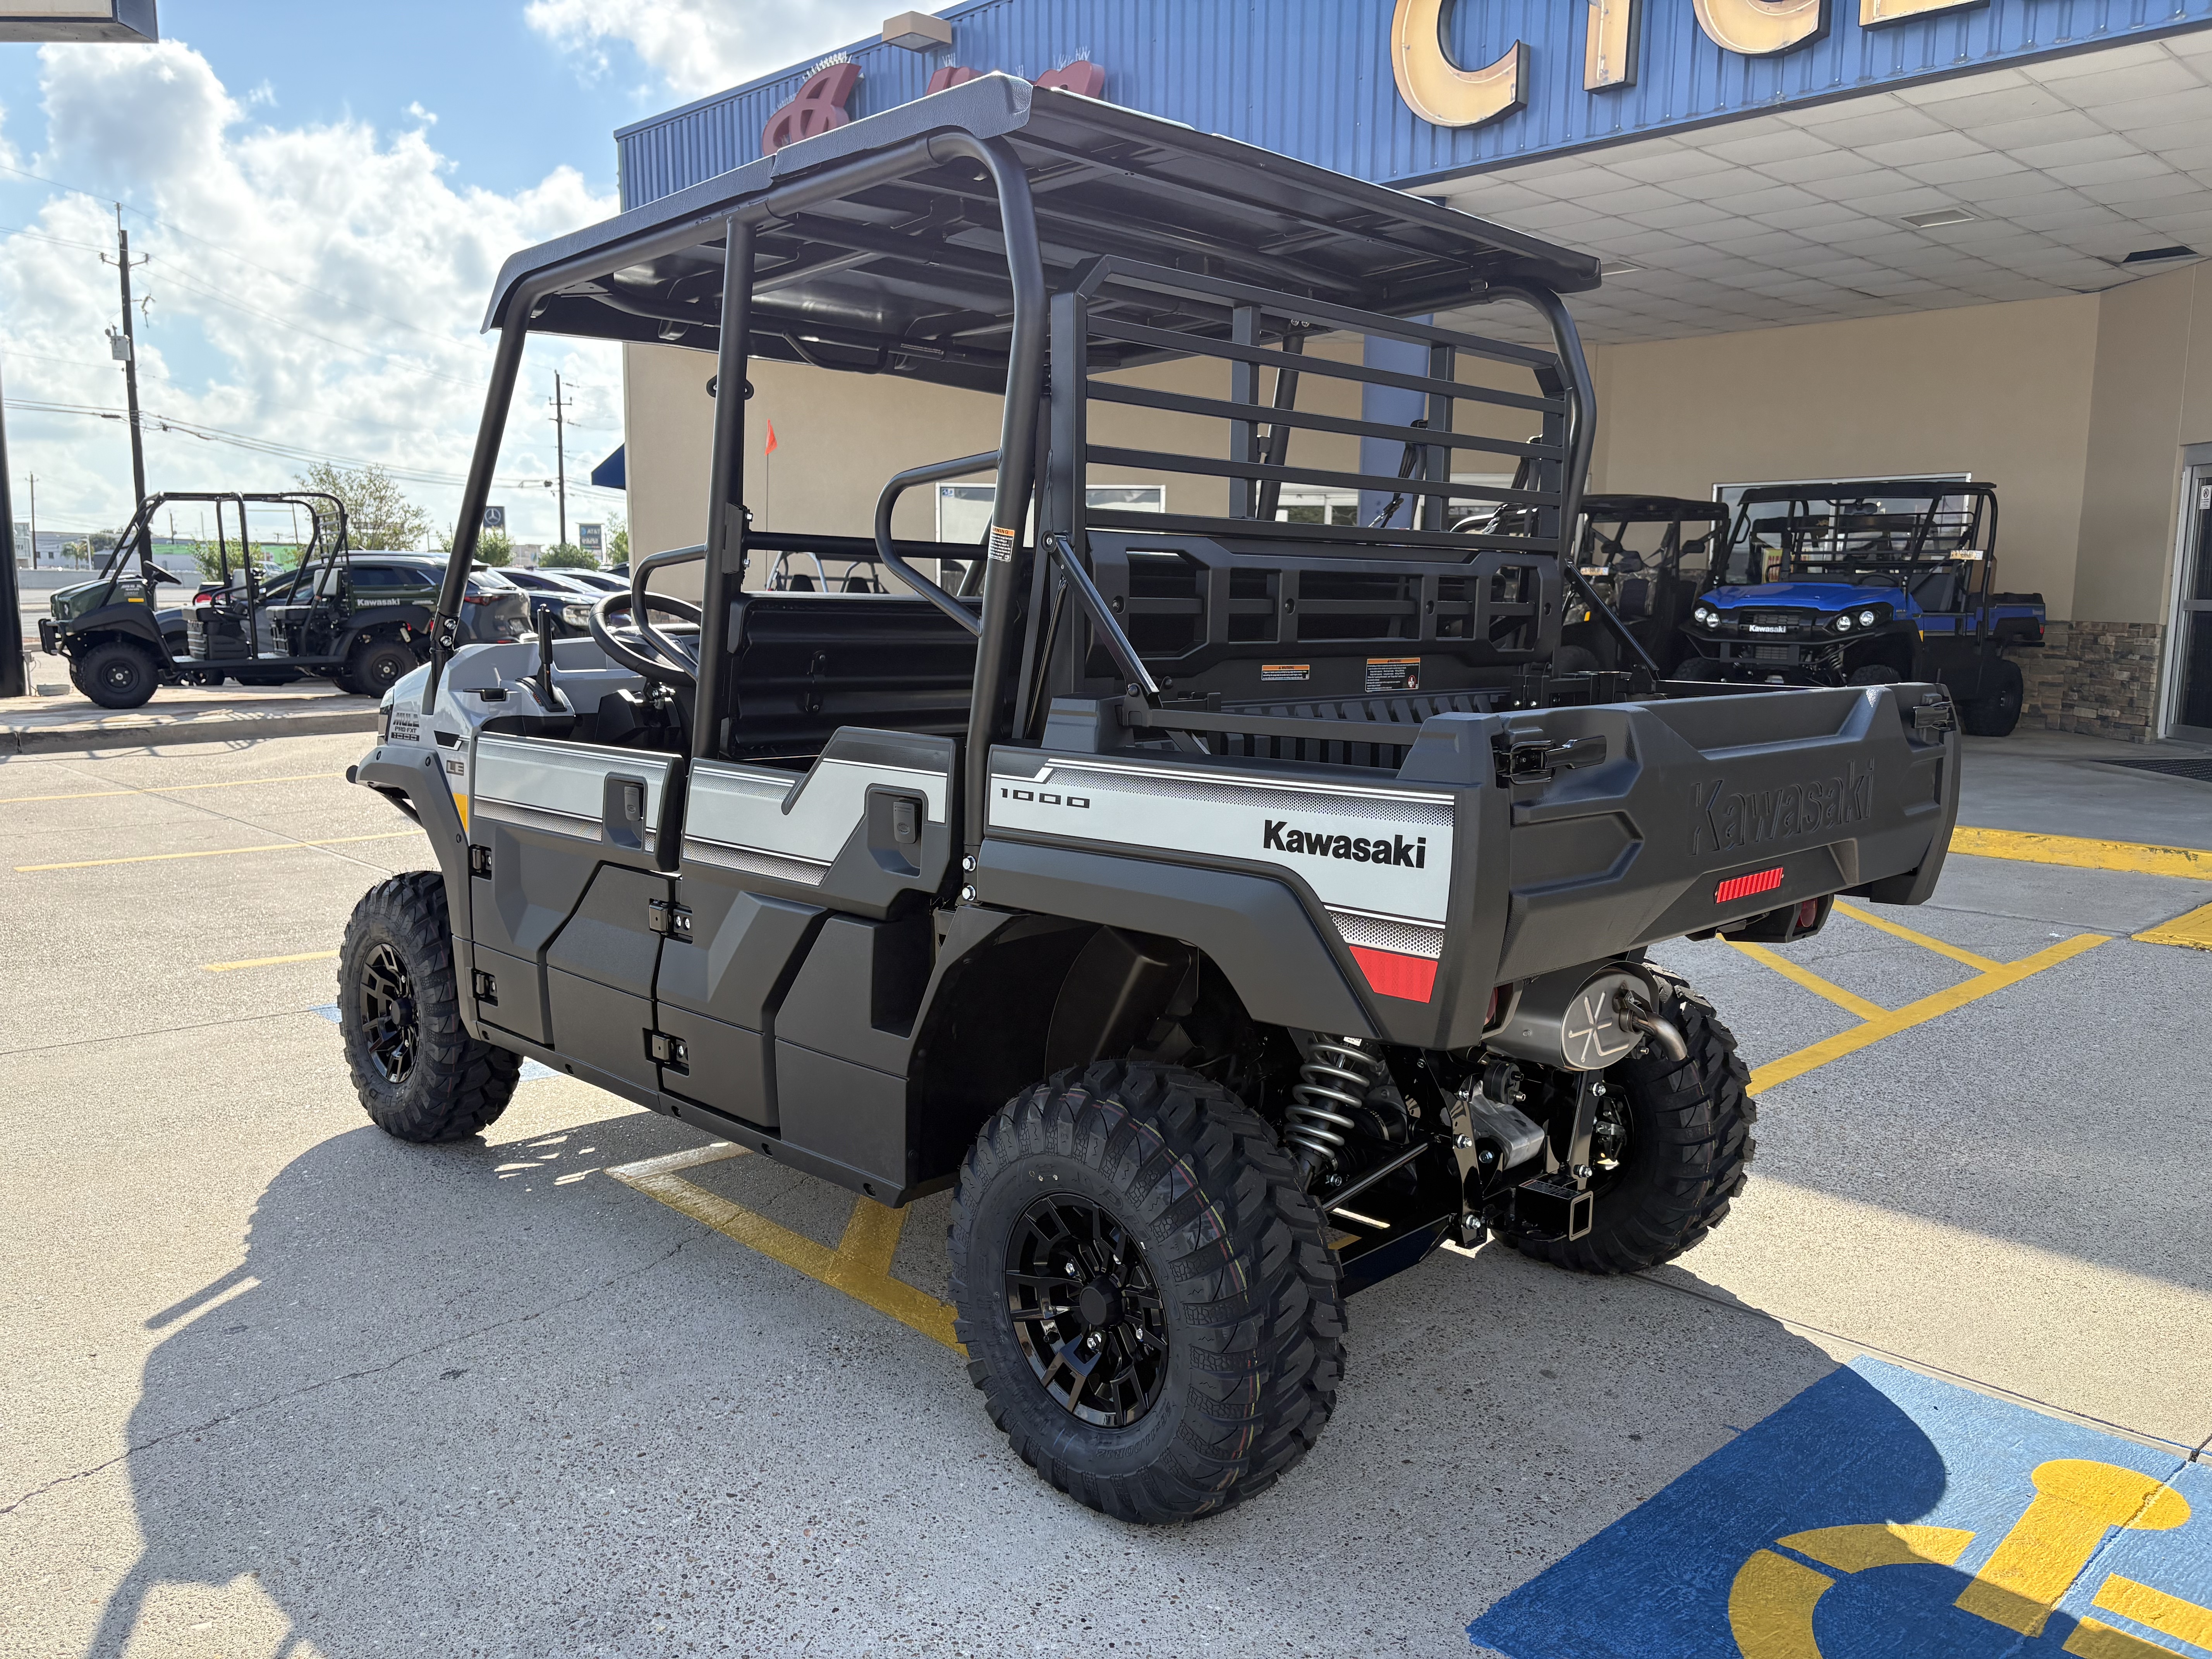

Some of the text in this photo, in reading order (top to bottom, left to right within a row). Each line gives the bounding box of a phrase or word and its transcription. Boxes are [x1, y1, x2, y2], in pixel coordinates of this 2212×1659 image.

[357, 598, 400, 606] Kawasaki
[1749, 624, 1786, 633] Kawasaki
[393, 712, 420, 728] MULE
[447, 761, 464, 774] LE
[1000, 787, 1090, 809] 1000
[1687, 757, 1875, 856] Kawasaki
[1263, 819, 1427, 869] Kawasaki
